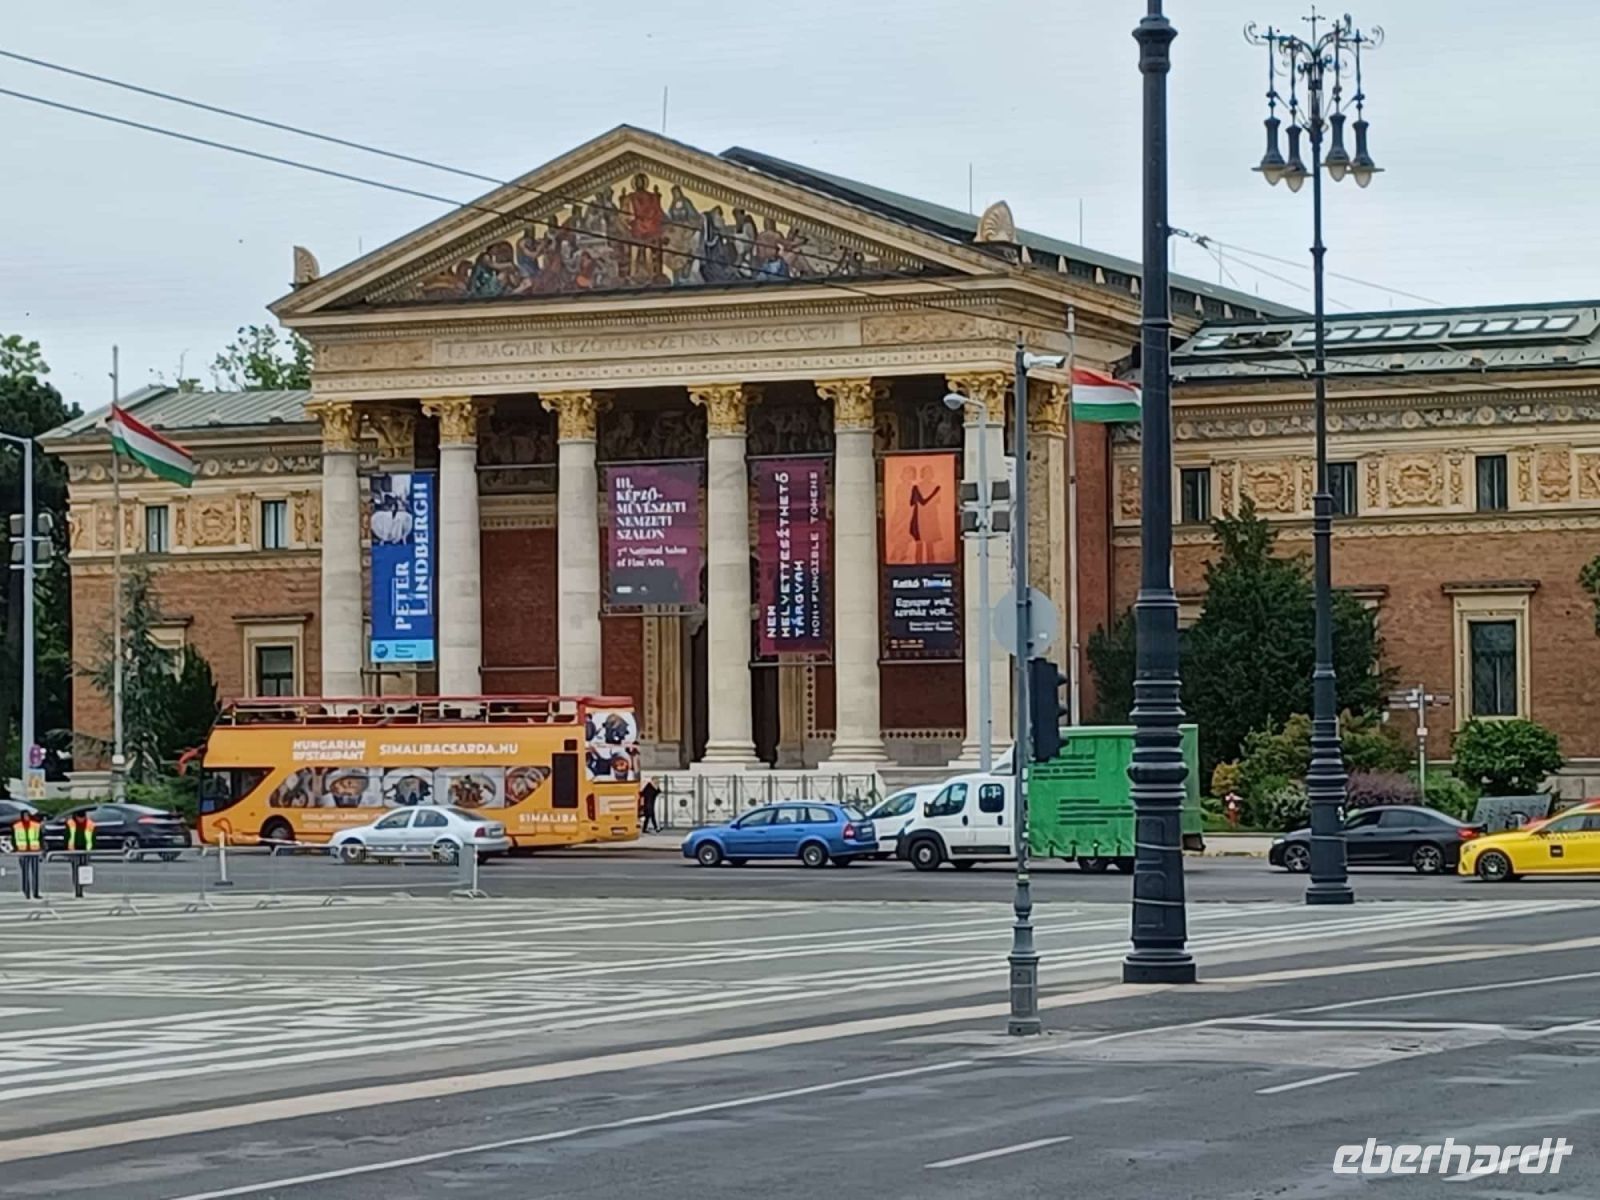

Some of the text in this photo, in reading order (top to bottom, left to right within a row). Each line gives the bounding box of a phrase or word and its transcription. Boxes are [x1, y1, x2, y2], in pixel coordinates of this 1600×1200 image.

[615, 477, 634, 489] III.
[616, 515, 672, 527] NEMZETI
[616, 529, 665, 540] SZALON
[408, 482, 429, 616] LINDBERGH
[395, 561, 412, 630] PETER
[767, 605, 777, 638] NEM
[293, 739, 366, 750] HUNGARIAN
[379, 743, 518, 756] SIMALIBACSARDA.HU
[292, 750, 365, 761] RESTAURANT
[519, 813, 577, 823] SIMALIBA
